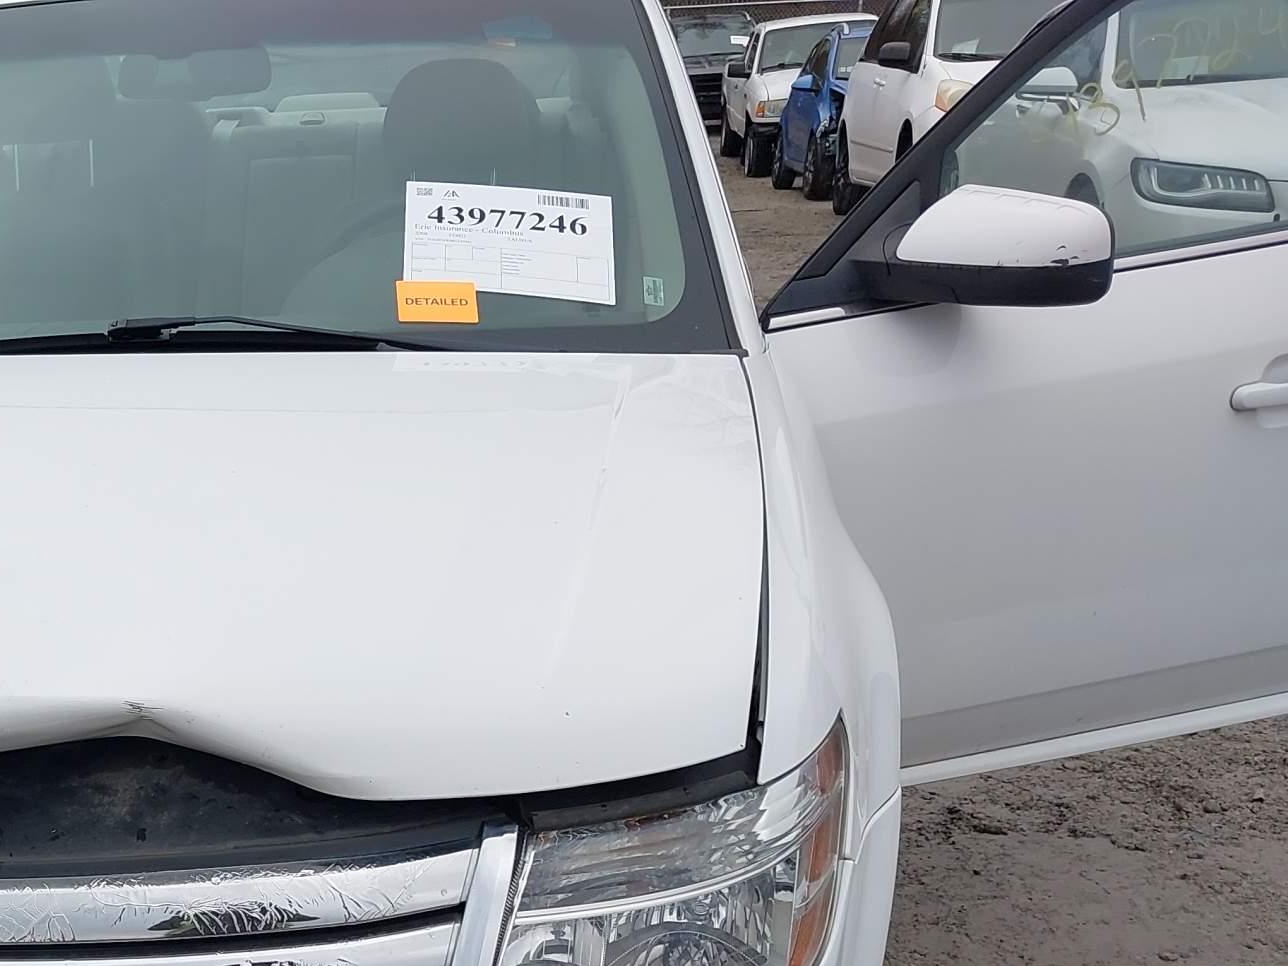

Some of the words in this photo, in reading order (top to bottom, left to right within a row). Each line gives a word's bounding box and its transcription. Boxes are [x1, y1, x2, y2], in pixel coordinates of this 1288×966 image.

[427, 205, 587, 235] 43977246
[434, 224, 474, 233] Insurance
[481, 227, 524, 236] Columbus
[405, 297, 469, 306] DETAILED
